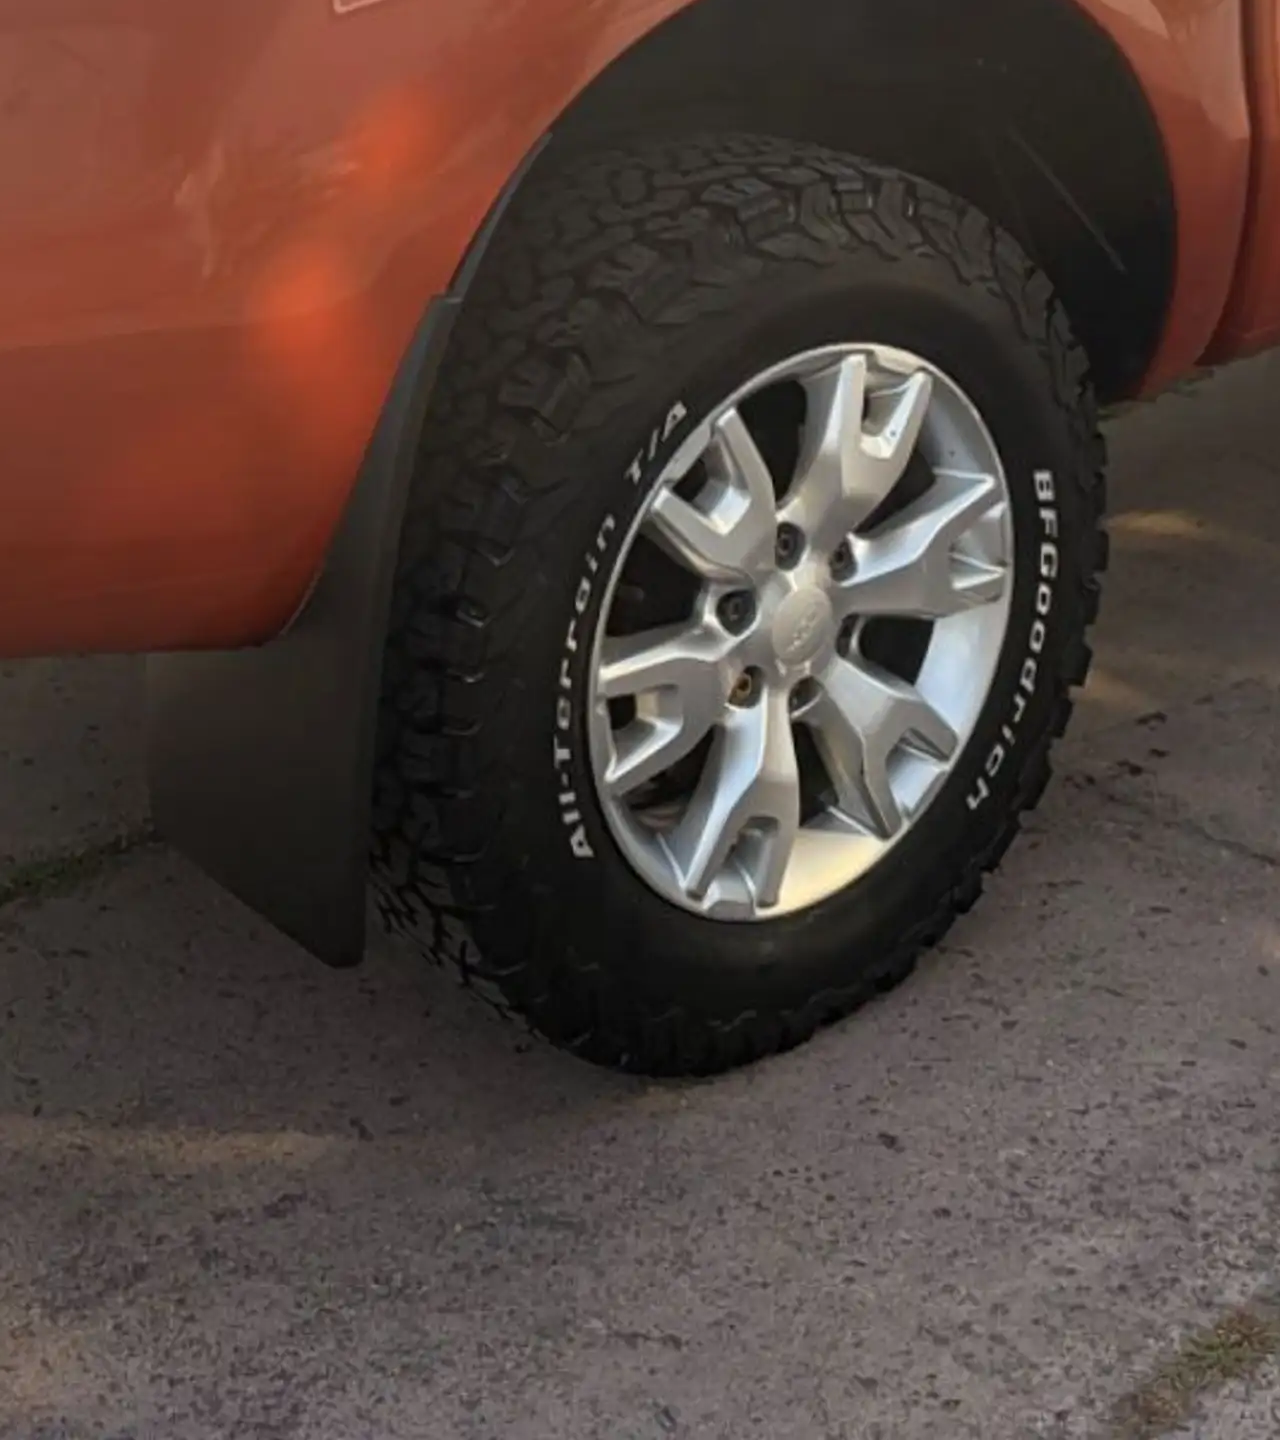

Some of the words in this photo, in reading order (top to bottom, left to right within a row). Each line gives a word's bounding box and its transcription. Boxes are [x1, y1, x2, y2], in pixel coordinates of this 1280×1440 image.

[553, 514, 617, 859] All-Terrain
[625, 400, 687, 486] T/A
[966, 469, 1061, 811] BFGoodrich
